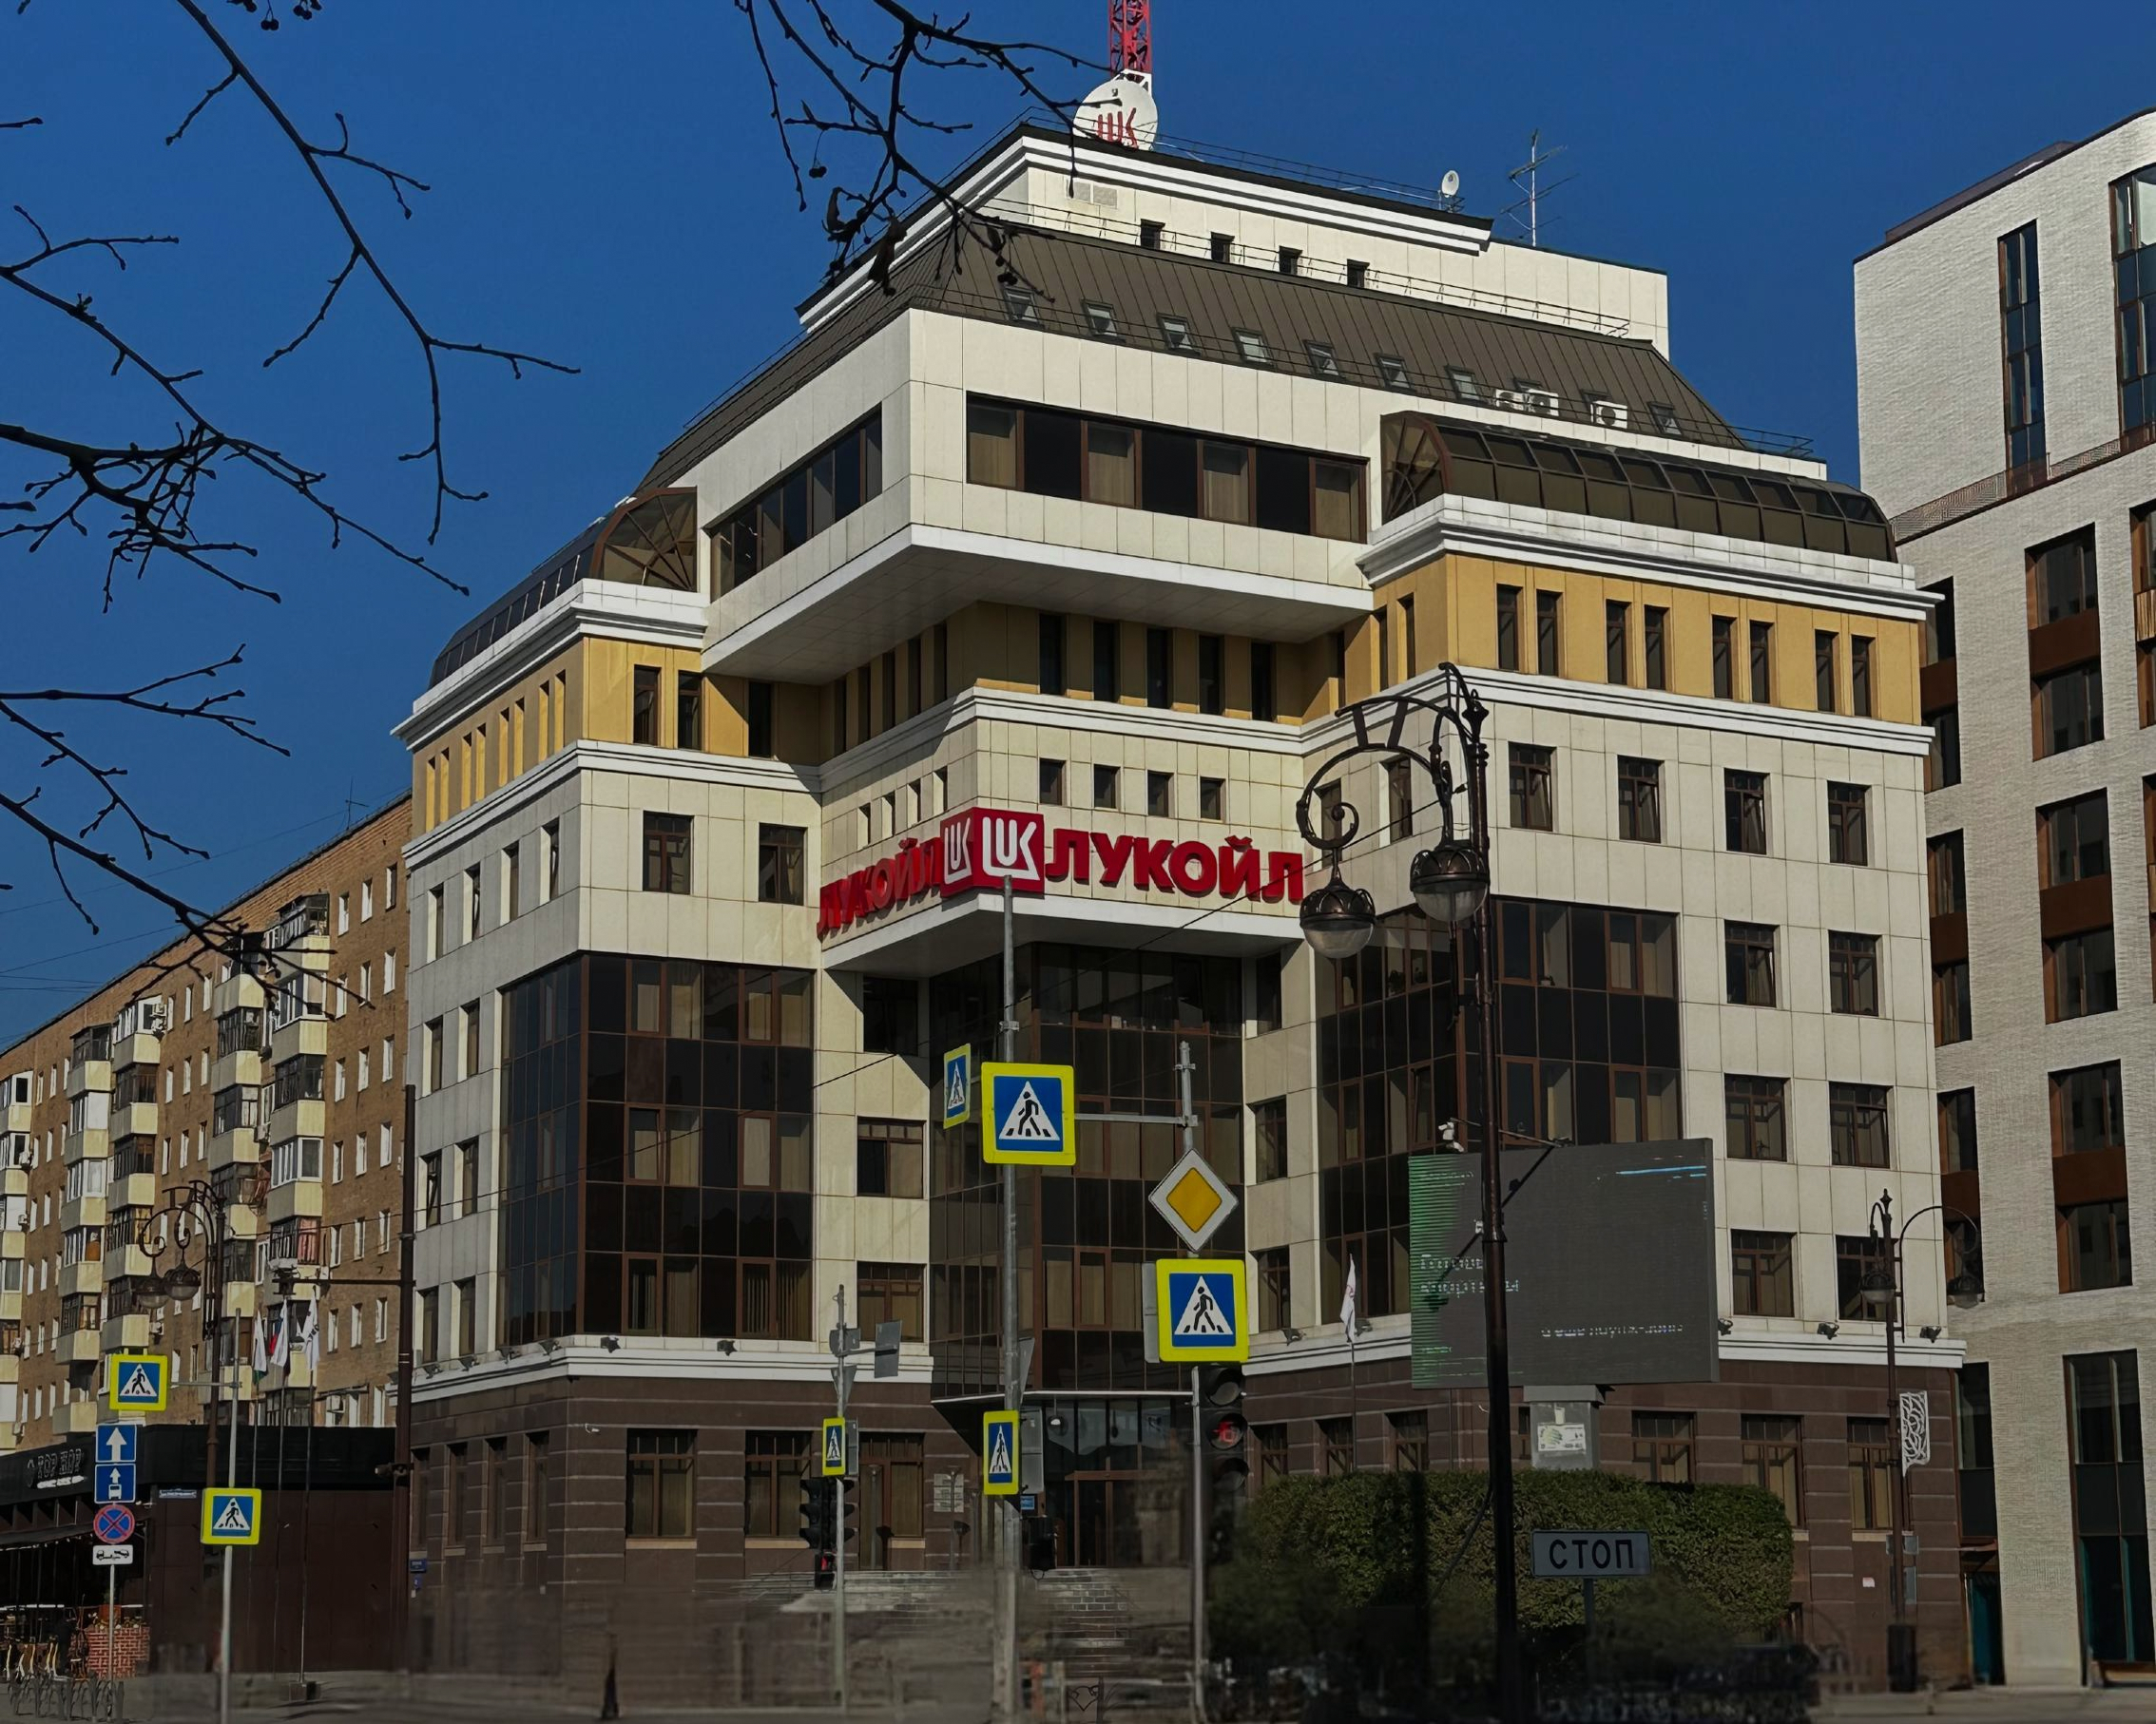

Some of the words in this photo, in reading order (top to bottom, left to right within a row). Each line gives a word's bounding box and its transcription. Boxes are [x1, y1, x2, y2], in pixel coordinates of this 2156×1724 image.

[817, 837, 943, 940] ЛУКОЙЛ
[1046, 828, 1304, 904] ЛУКОЙЛ
[1550, 1540, 1633, 1569] СТОП
